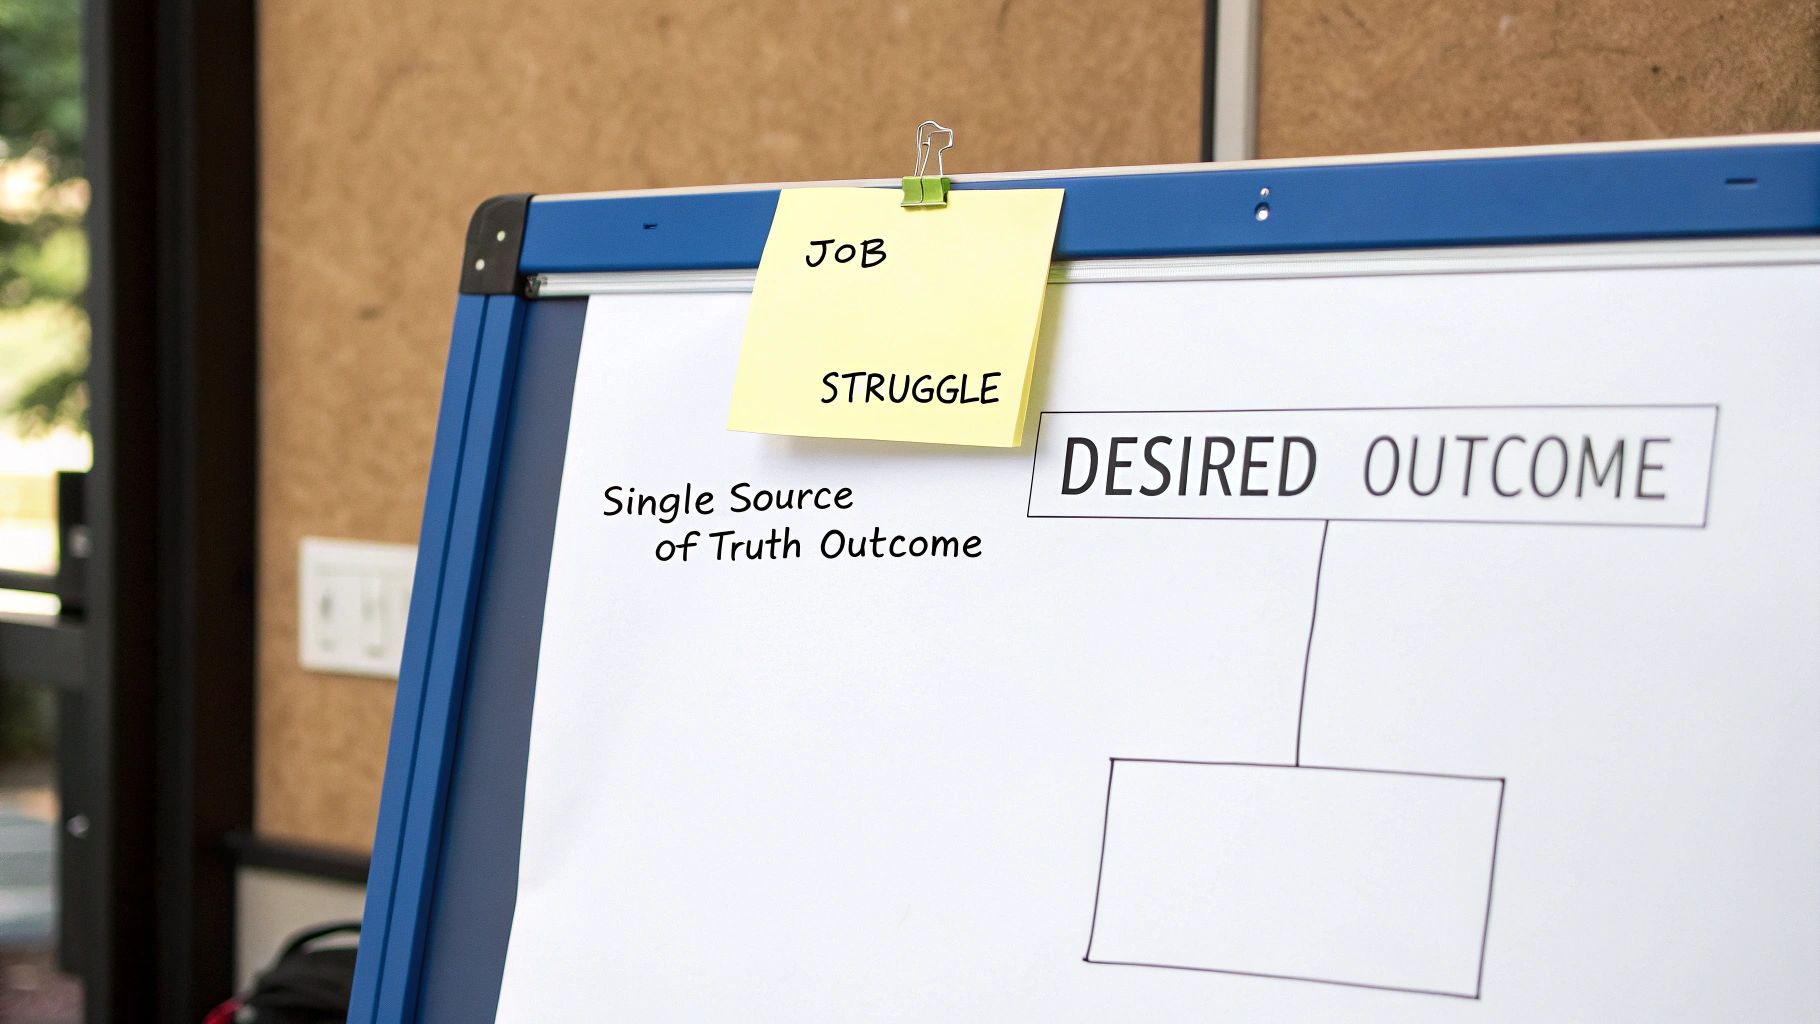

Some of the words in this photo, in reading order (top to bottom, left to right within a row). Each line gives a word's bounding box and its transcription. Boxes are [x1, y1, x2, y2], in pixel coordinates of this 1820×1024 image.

[820, 371, 1002, 405] STRUGGLE
[1060, 435, 1317, 497] DESIRED
[1363, 434, 1672, 500] OUTCOME
[603, 482, 714, 524] Single
[730, 482, 854, 513] Source
[655, 530, 701, 562] of
[708, 526, 801, 562] Truth
[820, 526, 982, 560] Outcome
